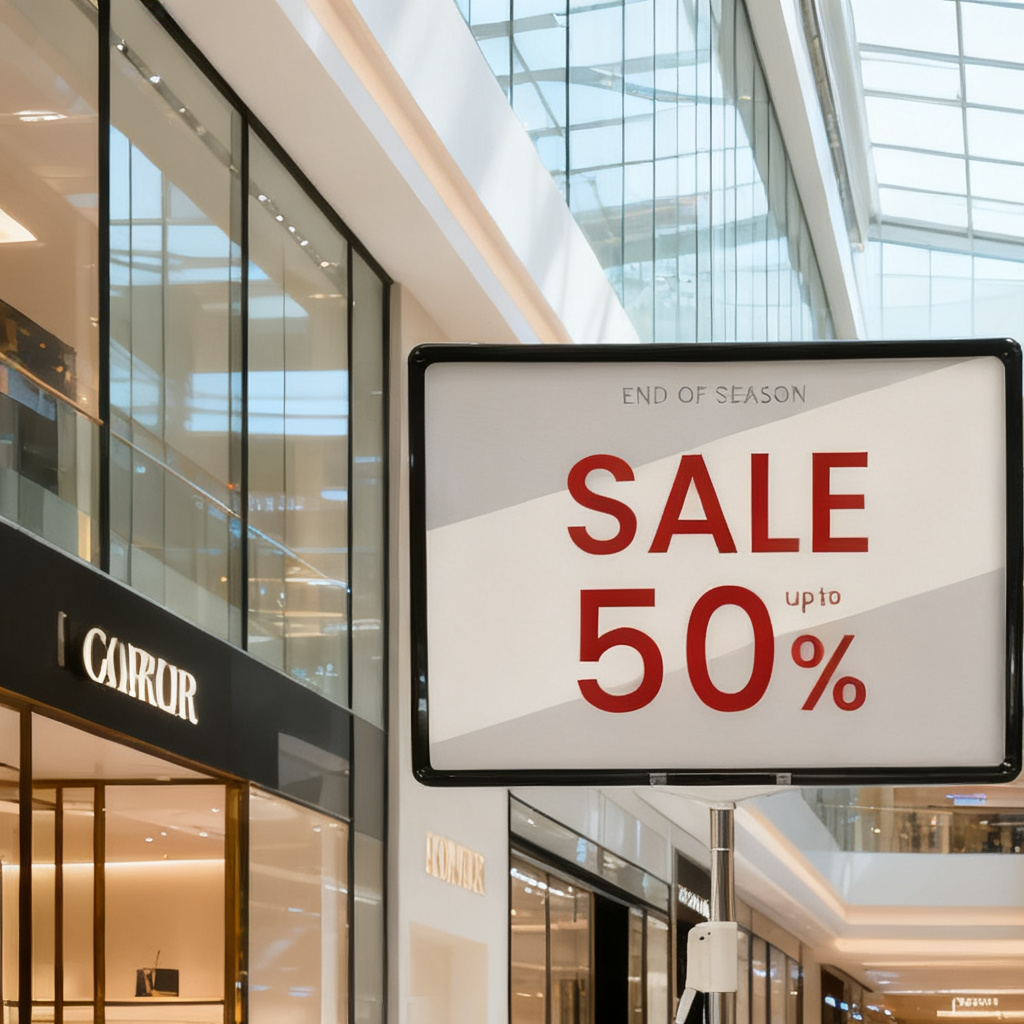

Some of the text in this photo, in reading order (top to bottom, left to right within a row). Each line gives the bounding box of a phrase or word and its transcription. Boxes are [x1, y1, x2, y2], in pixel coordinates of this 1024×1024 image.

[622, 384, 806, 405] END OF SEASON
[567, 452, 869, 556] SALE
